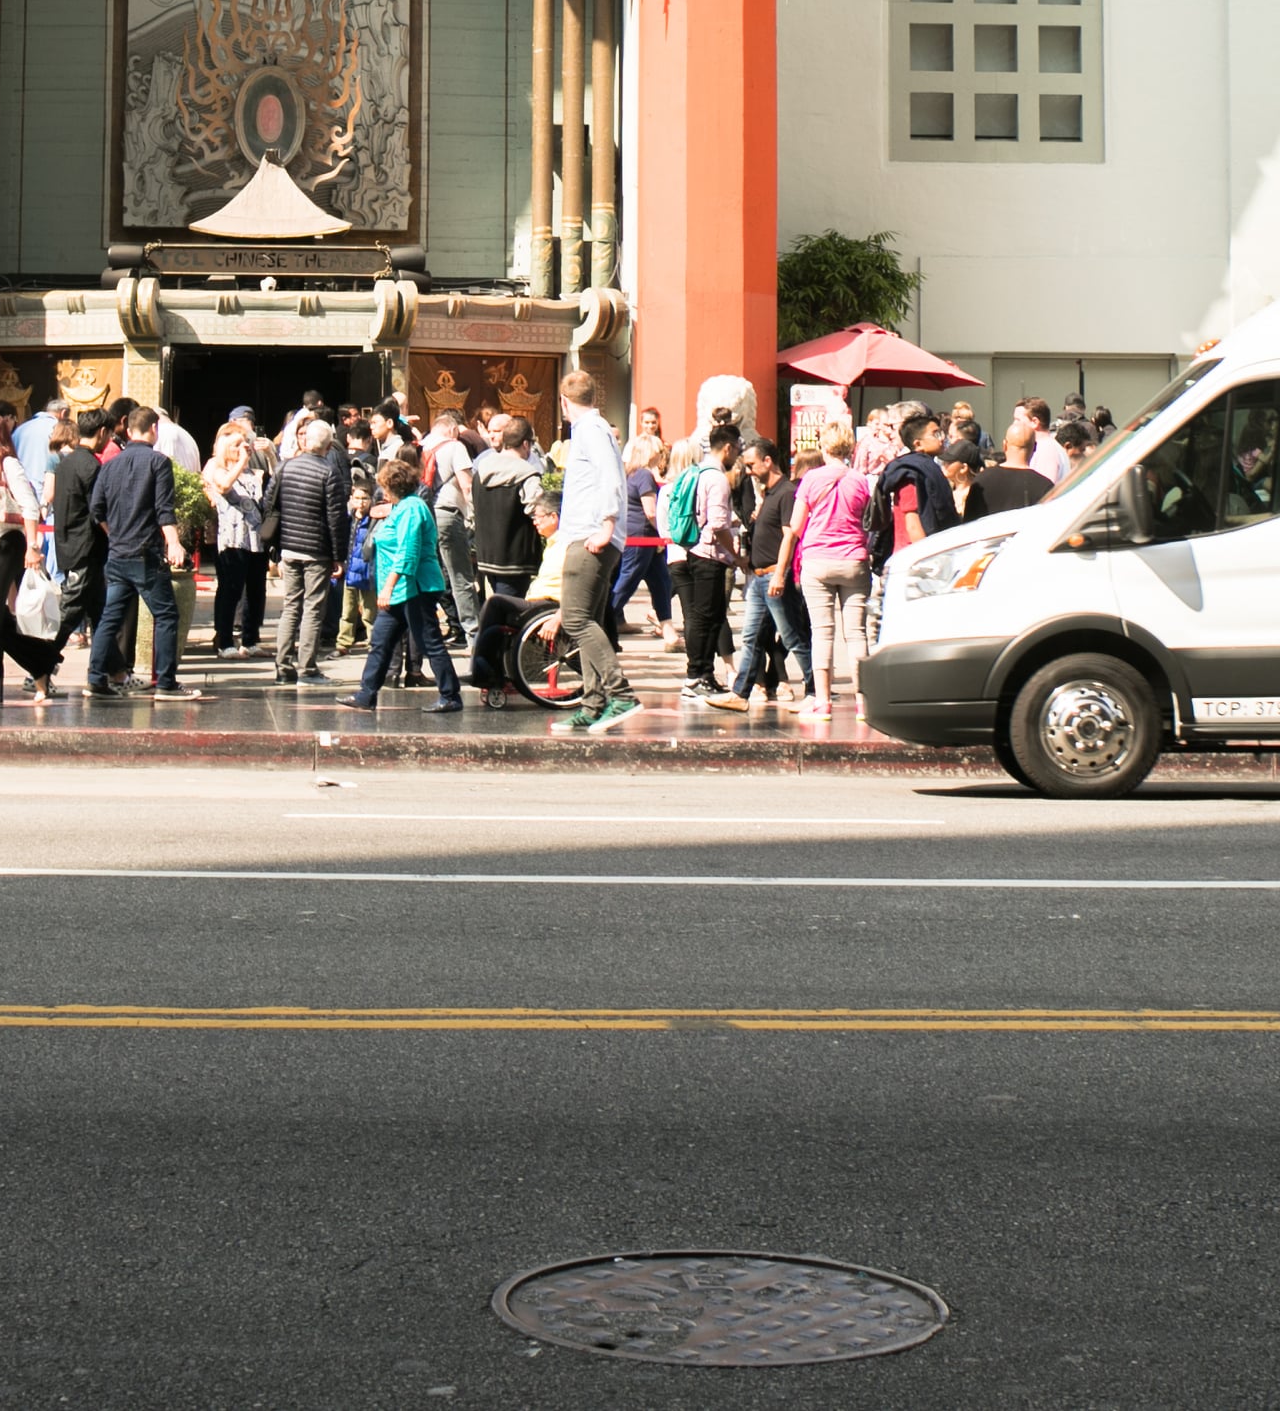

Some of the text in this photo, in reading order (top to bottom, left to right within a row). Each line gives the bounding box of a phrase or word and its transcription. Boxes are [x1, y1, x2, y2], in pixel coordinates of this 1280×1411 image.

[158, 251, 205, 268] TCL
[213, 252, 287, 269] CHINESE
[795, 410, 825, 426] TAKE
[796, 426, 819, 440] THE
